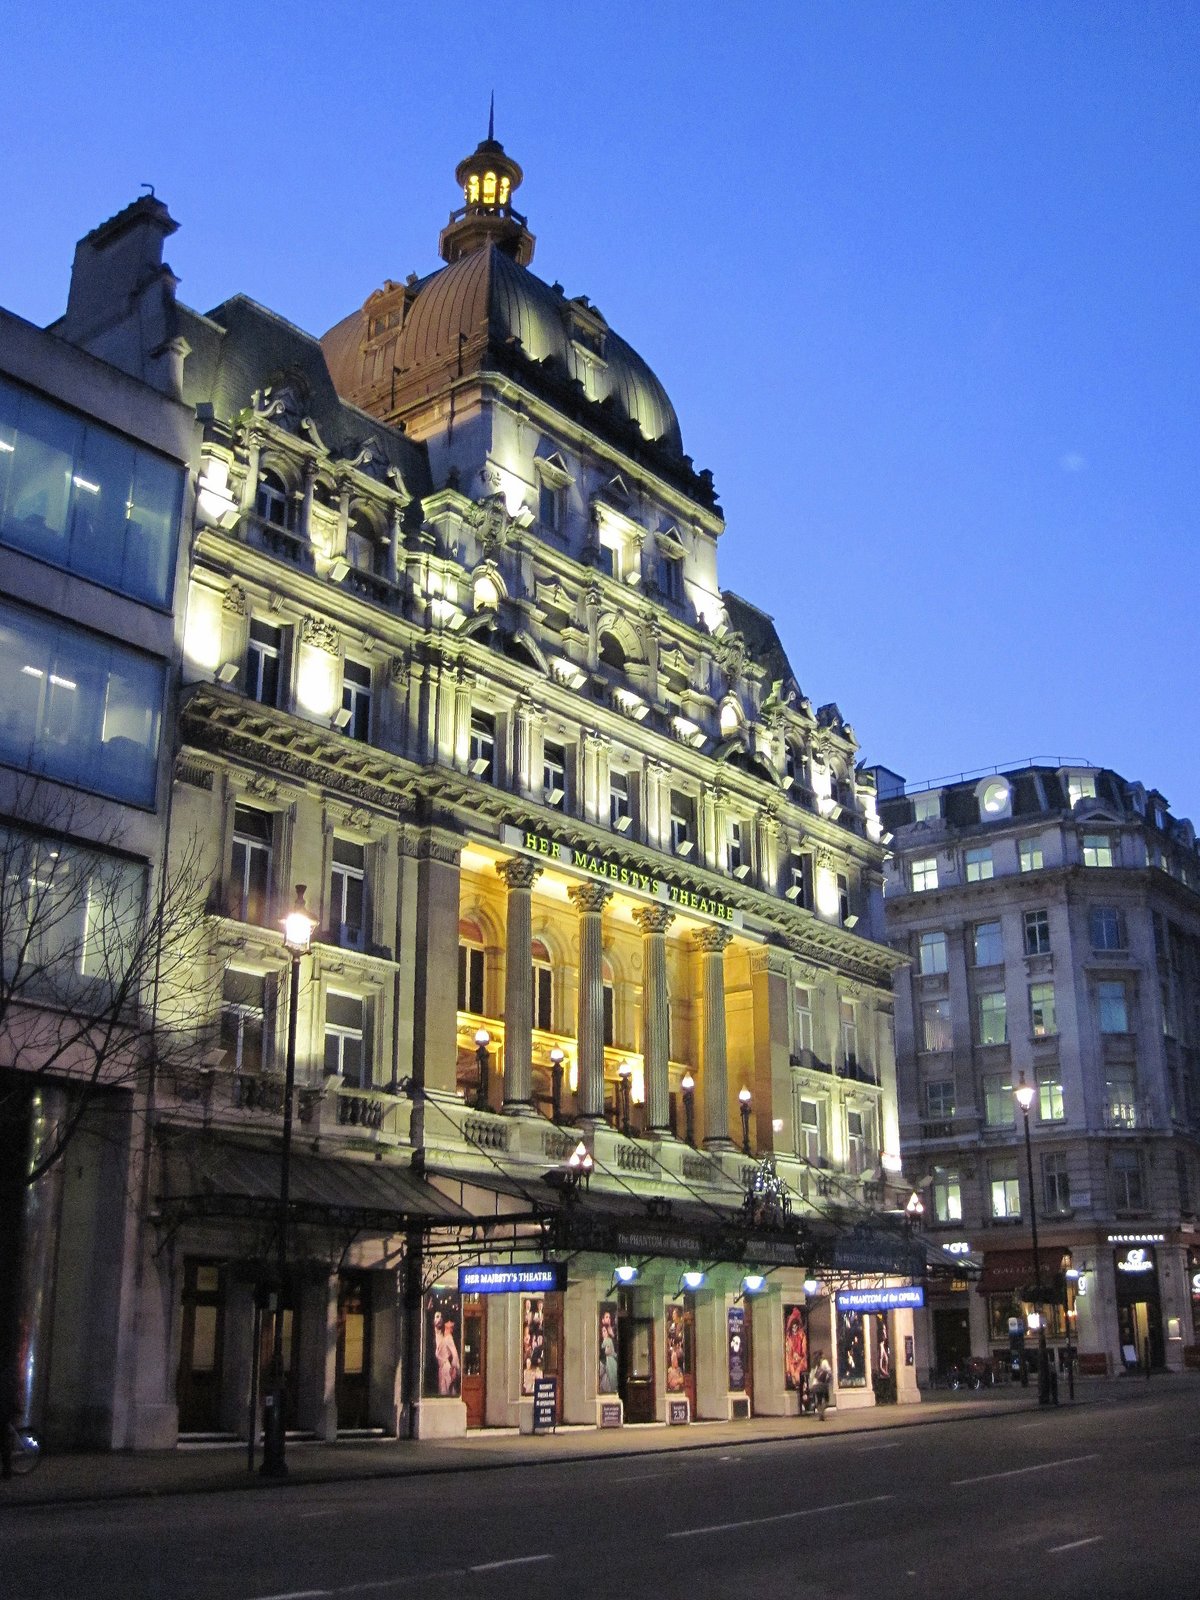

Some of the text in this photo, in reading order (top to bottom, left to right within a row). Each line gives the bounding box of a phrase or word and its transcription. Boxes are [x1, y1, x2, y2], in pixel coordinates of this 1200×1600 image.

[526, 833, 735, 921] HER MAJESTY'S THEATRE
[464, 1271, 552, 1285] HER MAJESTY'S THEATRE
[838, 1296, 849, 1305] The
[850, 1294, 881, 1305] PHANTOM
[899, 1292, 920, 1302] OPERA
